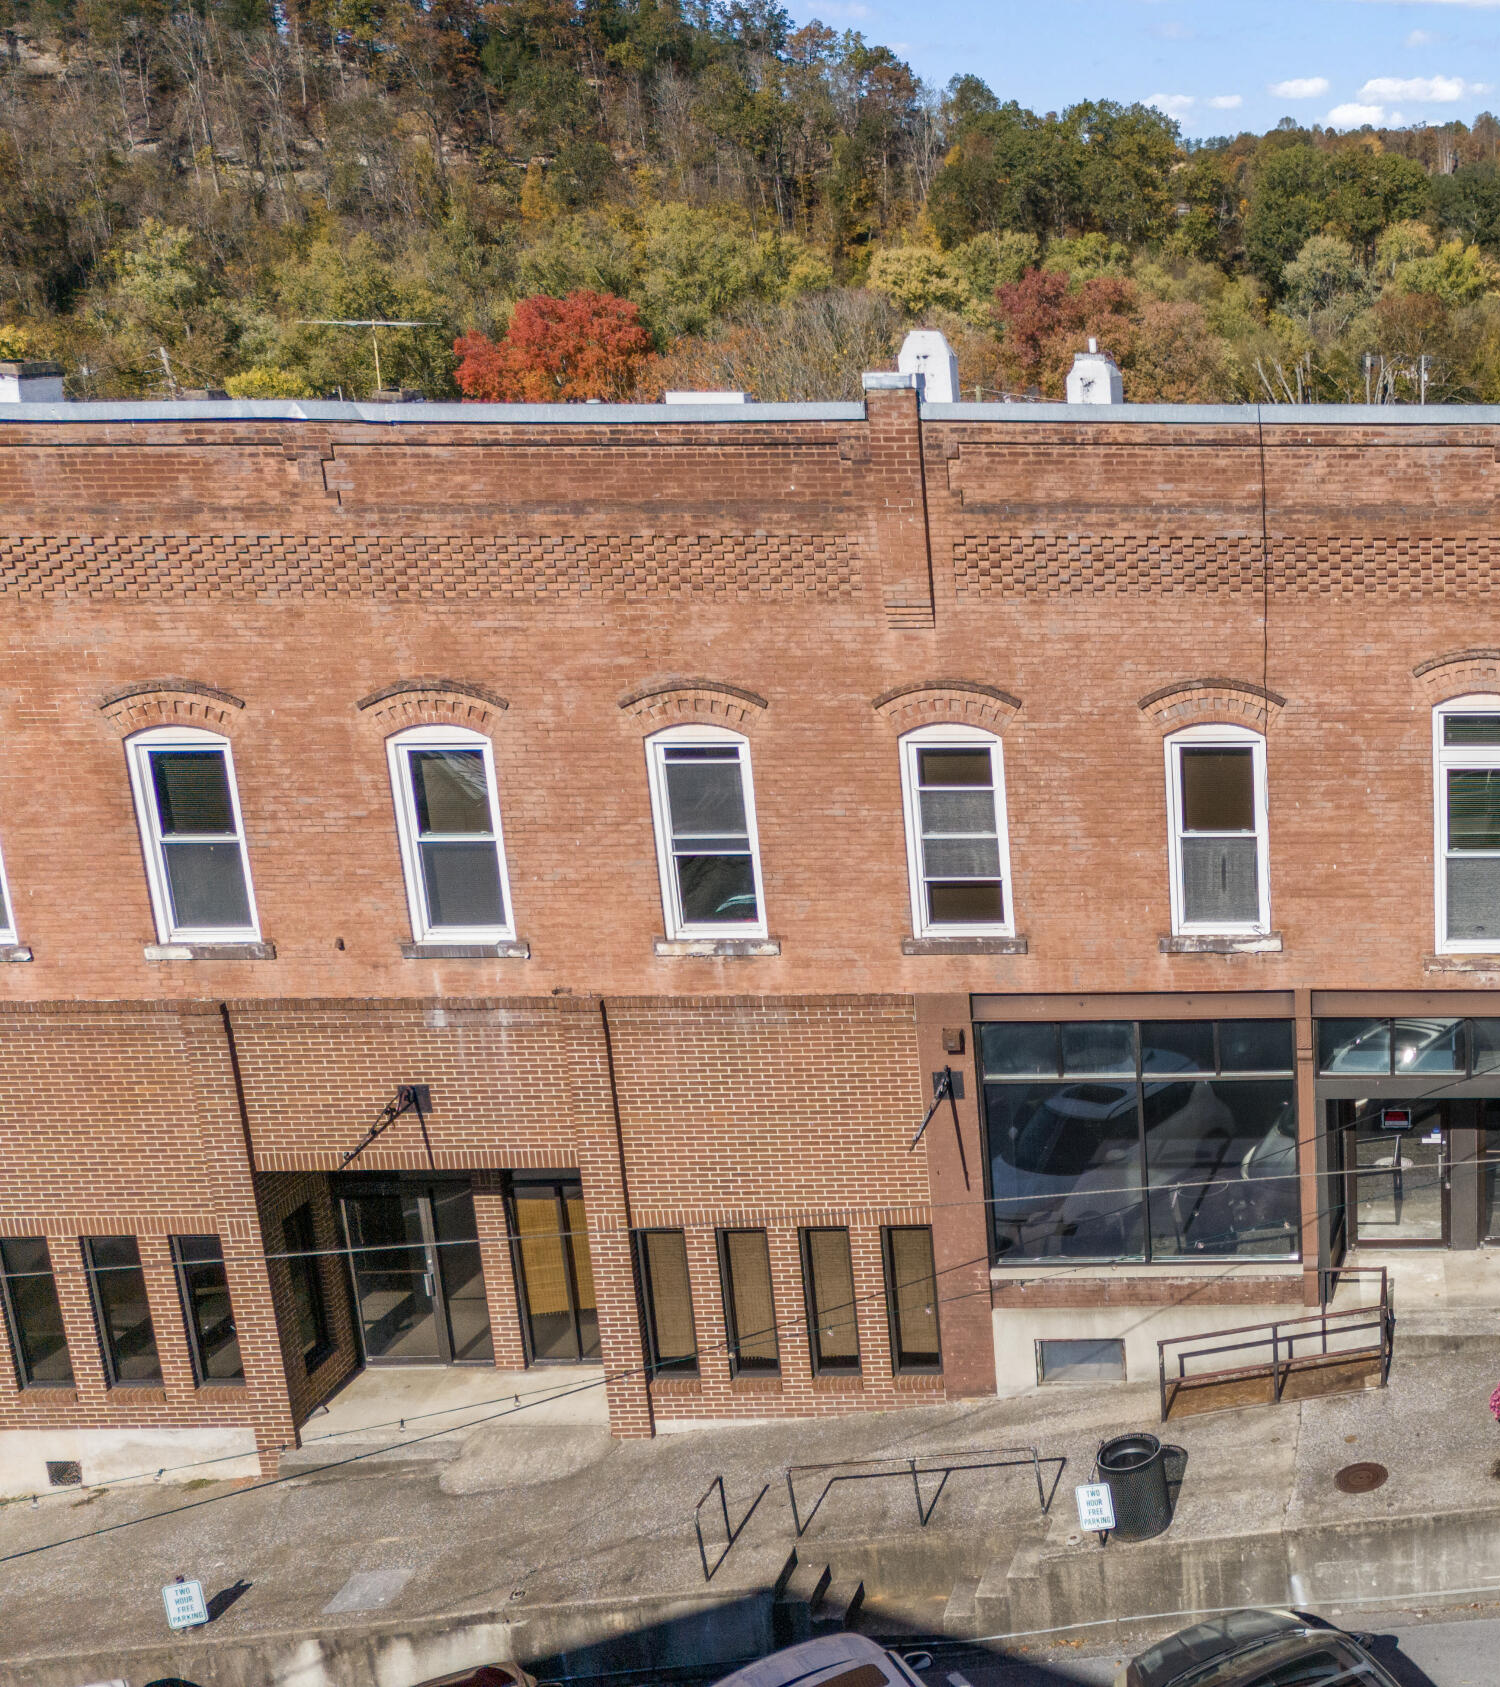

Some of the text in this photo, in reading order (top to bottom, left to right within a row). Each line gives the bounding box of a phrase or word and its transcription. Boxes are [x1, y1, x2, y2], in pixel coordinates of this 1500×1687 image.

[1086, 1489, 1100, 1497] TWO
[1086, 1498, 1103, 1507] HOUR
[1088, 1507, 1103, 1515] FREE
[1084, 1516, 1111, 1525] PARKING
[174, 1587, 191, 1596] TWO
[175, 1595, 194, 1605] HOUR
[177, 1604, 195, 1613] FREE
[172, 1611, 204, 1623] PARKING
